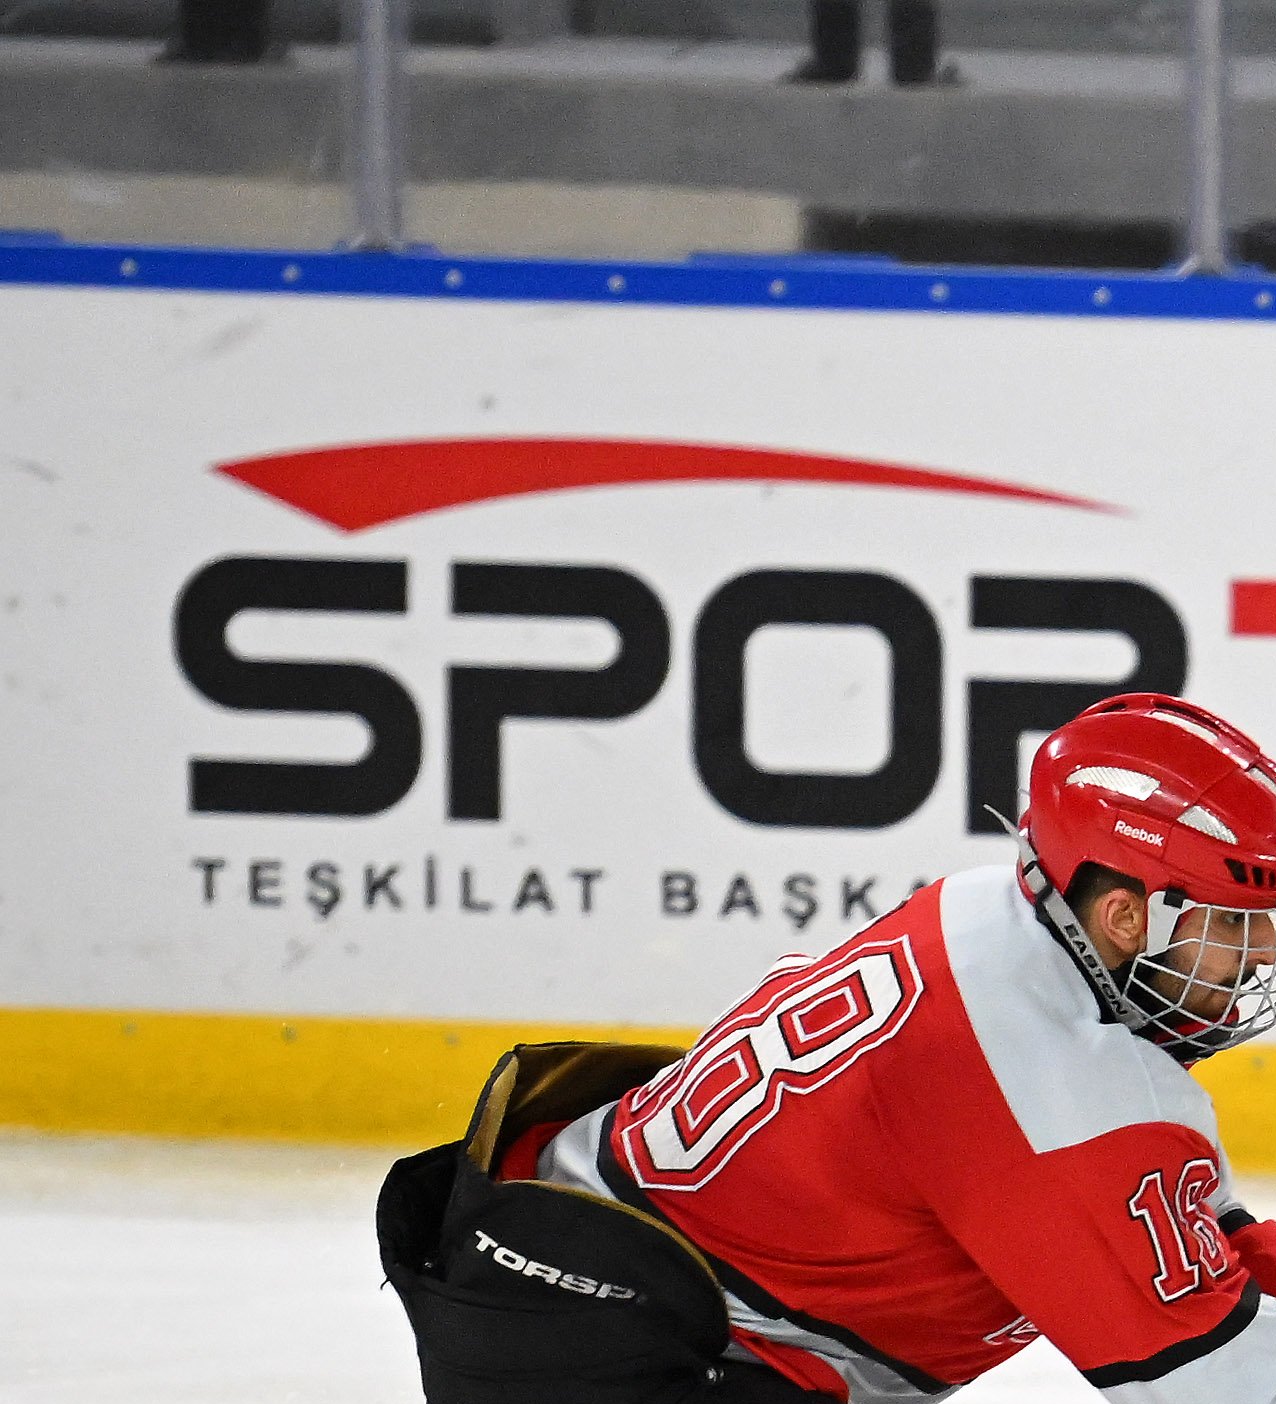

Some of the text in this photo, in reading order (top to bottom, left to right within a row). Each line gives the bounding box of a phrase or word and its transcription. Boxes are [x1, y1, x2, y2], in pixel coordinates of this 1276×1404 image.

[1113, 819, 1167, 848] Reebok
[191, 855, 609, 920] TEŞKİLAT
[1064, 923, 1128, 1018] EASTON
[621, 934, 925, 1192] 8
[474, 1229, 640, 1301] TORSP
